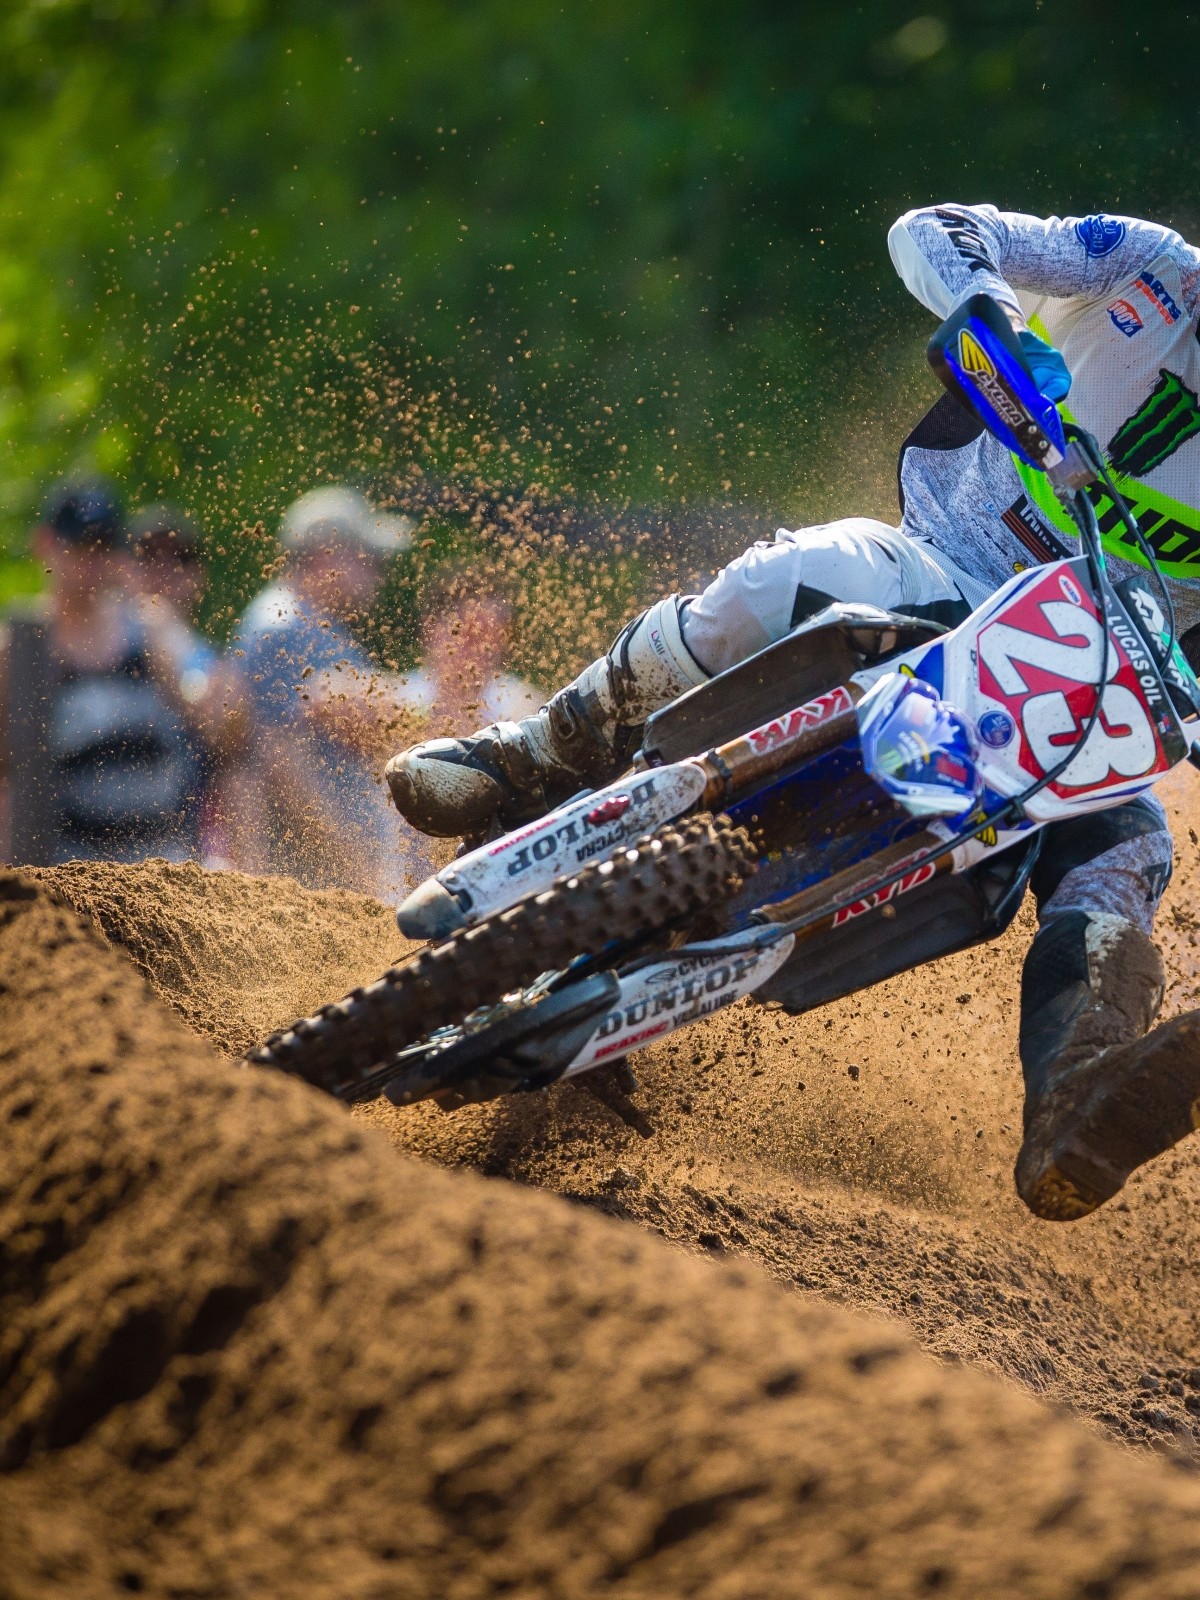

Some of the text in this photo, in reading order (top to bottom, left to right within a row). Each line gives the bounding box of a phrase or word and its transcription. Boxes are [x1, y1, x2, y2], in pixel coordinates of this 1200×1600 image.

[1107, 301, 1138, 333] 100%
[976, 370, 1025, 427] CYCRA
[978, 600, 1157, 787] 23
[1107, 615, 1162, 706] LUCAS OIL
[596, 955, 759, 1042] DUNLOP
